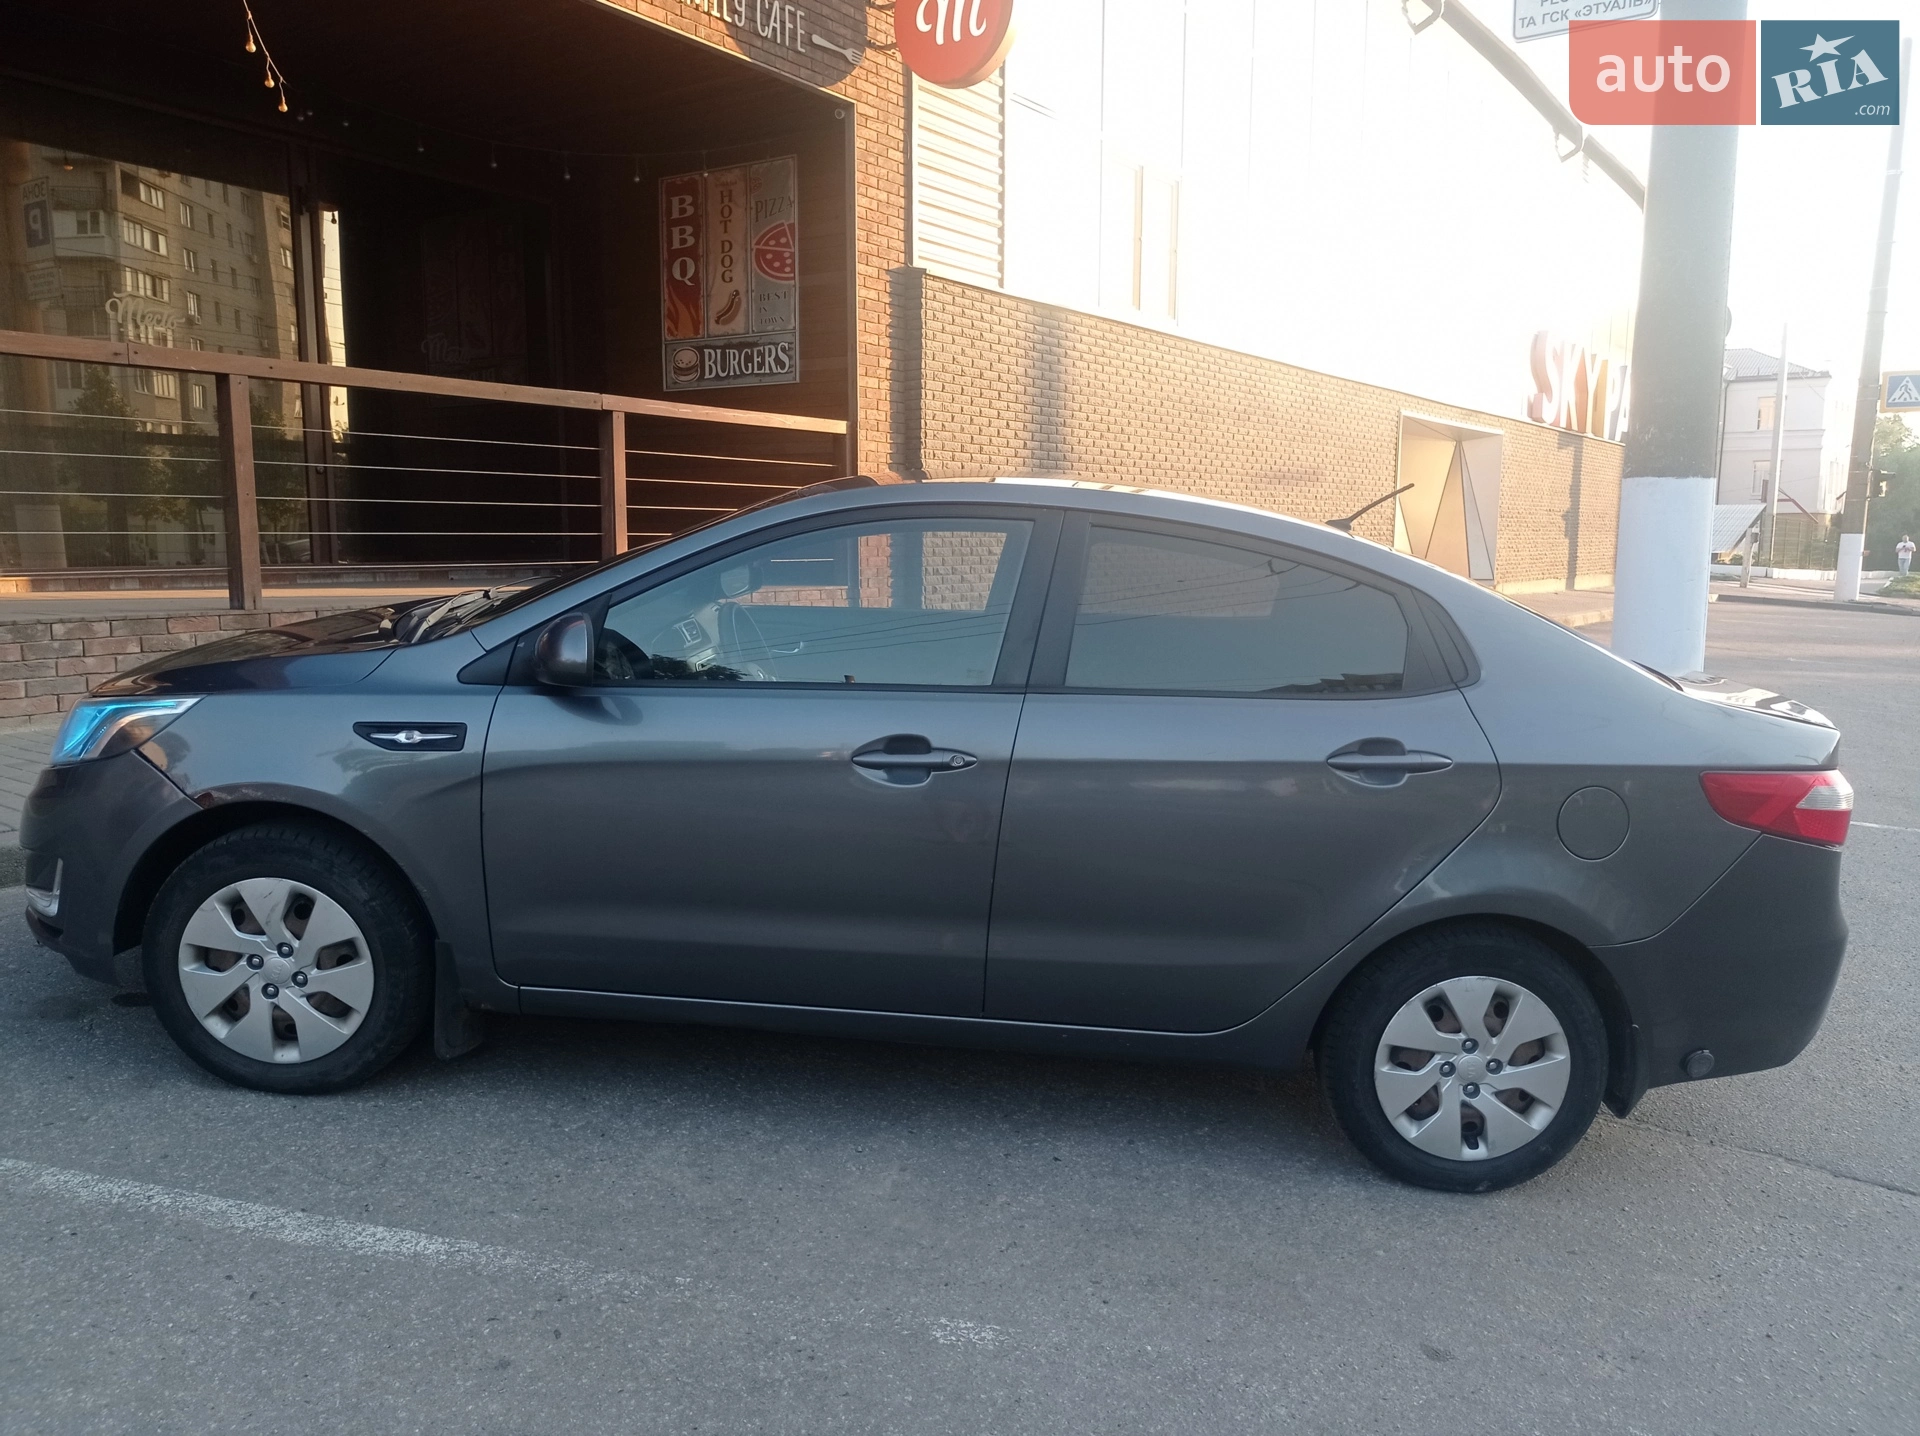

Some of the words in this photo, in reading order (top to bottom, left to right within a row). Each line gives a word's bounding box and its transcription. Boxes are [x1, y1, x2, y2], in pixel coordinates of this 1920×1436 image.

[757, 0, 806, 53] CAFE
[1519, 16, 1536, 29] ТА
[1542, 9, 1569, 25] ГСК
[720, 189, 733, 234] HOT
[755, 196, 795, 223] PIZZA
[670, 194, 696, 286] BBQ
[721, 240, 733, 283] DOG
[704, 342, 790, 379] BURGERS
